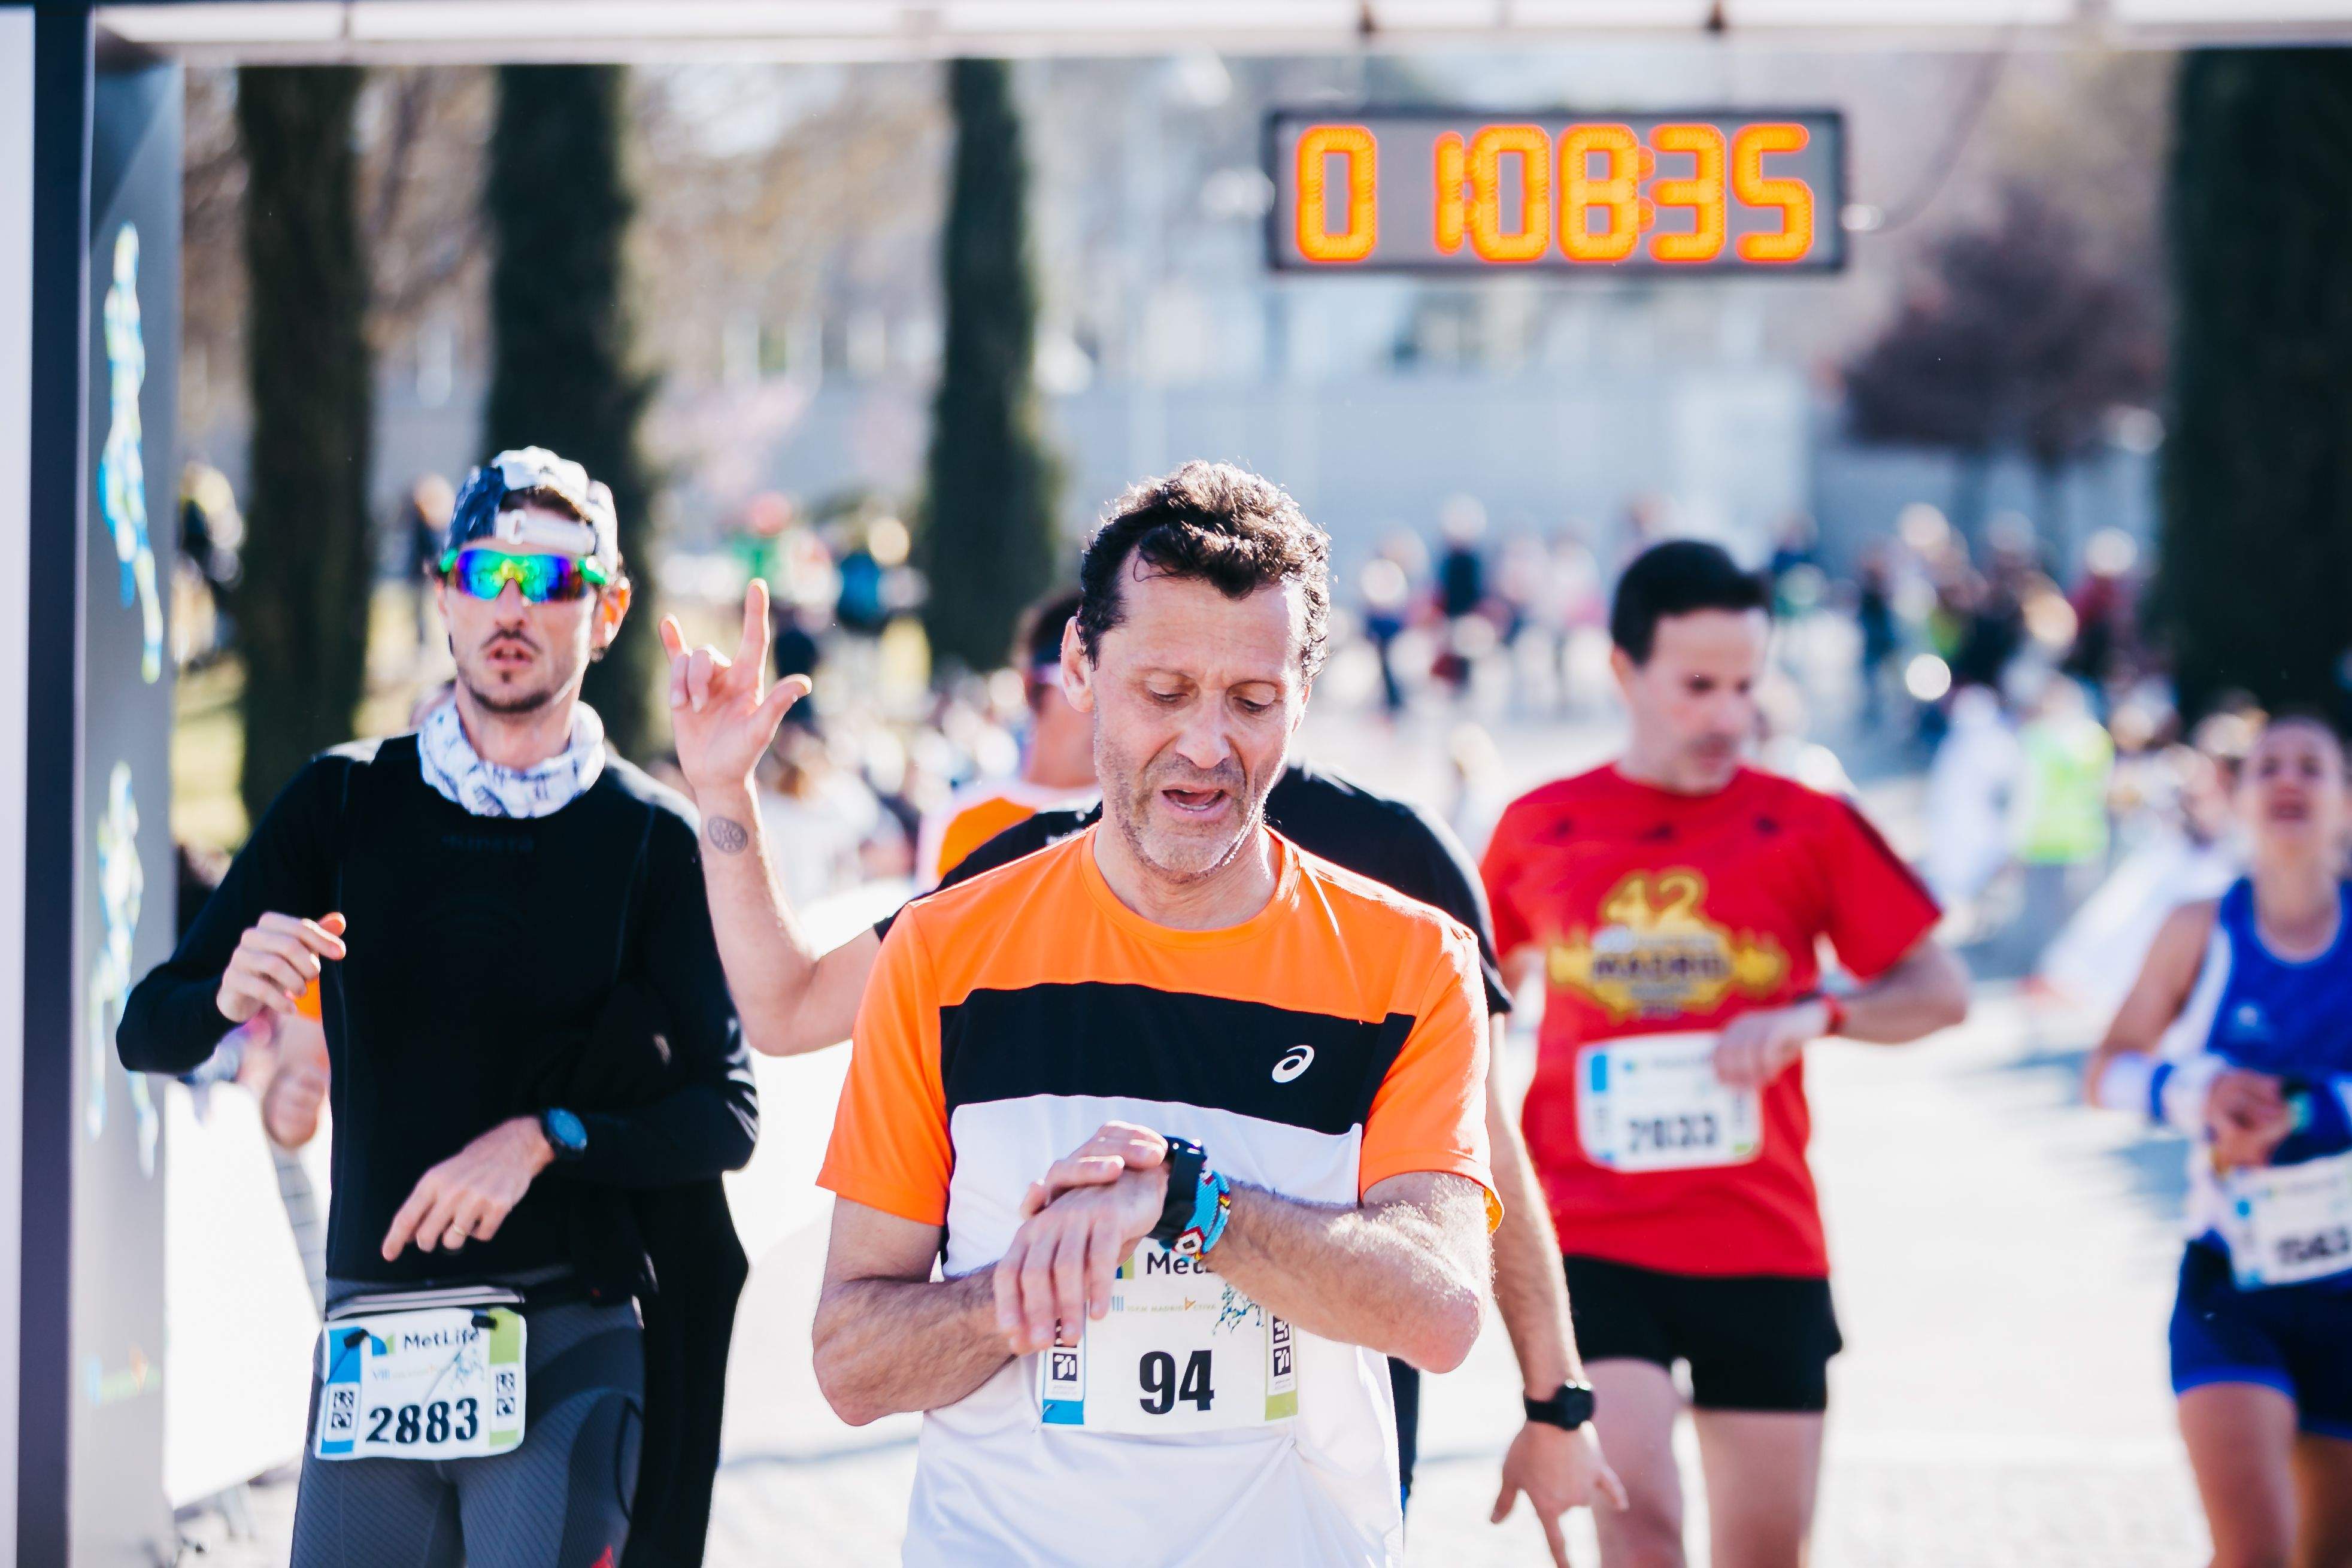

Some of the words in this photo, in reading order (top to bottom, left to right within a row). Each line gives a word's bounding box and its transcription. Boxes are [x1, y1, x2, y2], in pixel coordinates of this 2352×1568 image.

[1296, 124, 1377, 262] 0
[1605, 873, 1704, 932] 42
[404, 1326, 480, 1351] MetLife
[1139, 1349, 1216, 1415] 94
[365, 1397, 478, 1444] 2883
